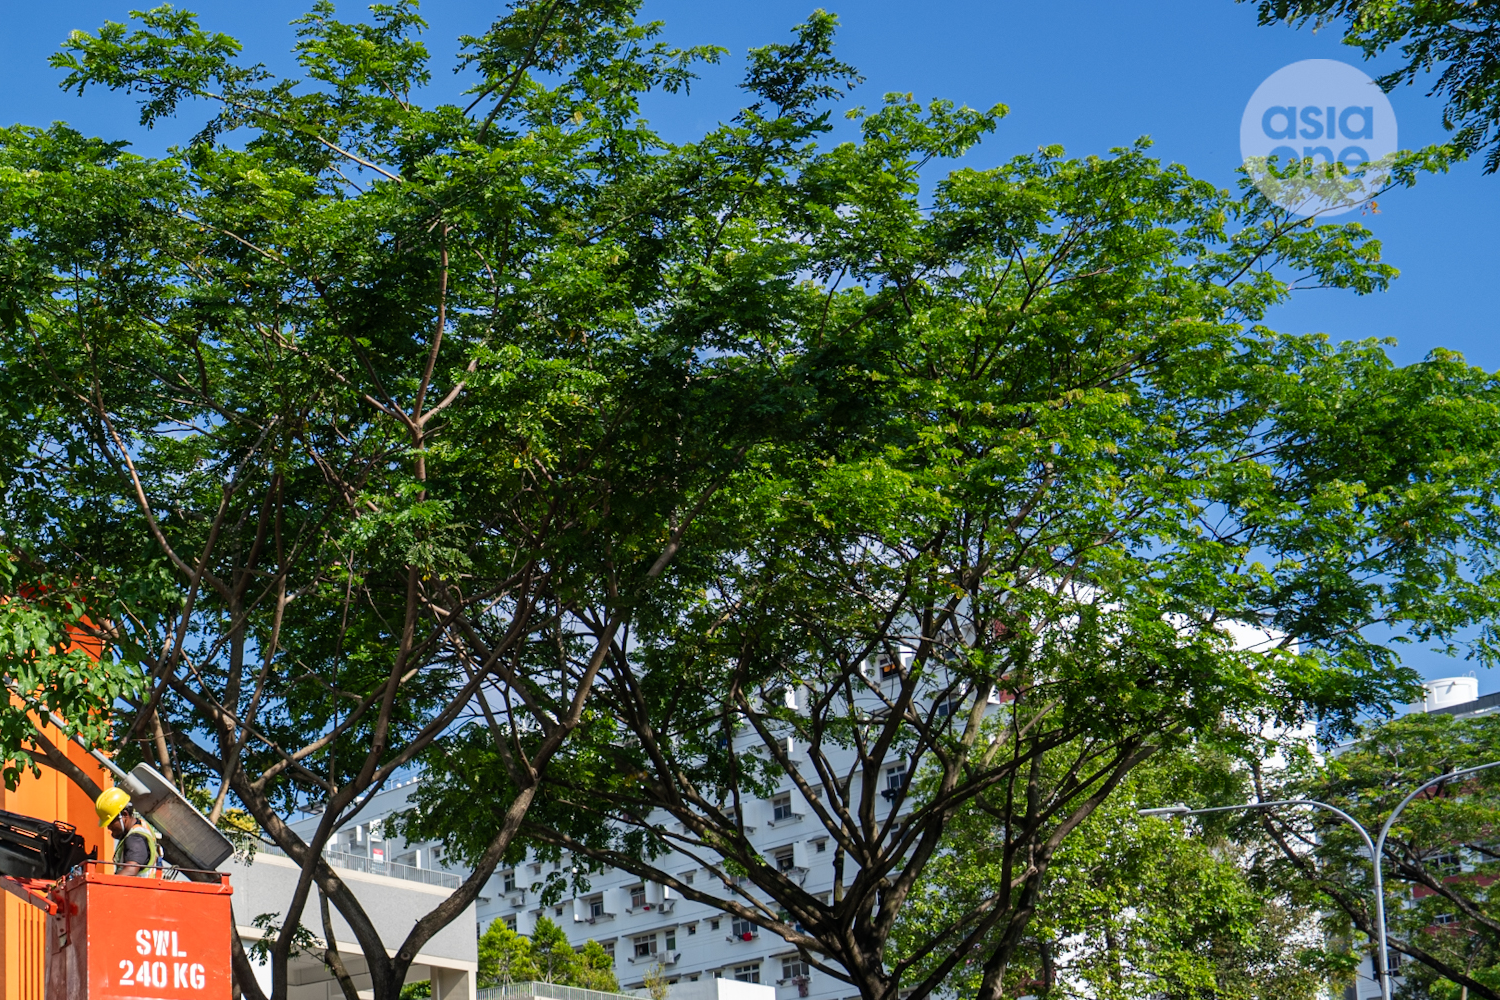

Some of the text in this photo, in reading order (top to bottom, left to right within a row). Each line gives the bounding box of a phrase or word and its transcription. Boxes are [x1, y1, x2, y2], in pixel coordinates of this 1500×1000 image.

[135, 929, 187, 957] SWL
[118, 960, 205, 990] 240 KG
